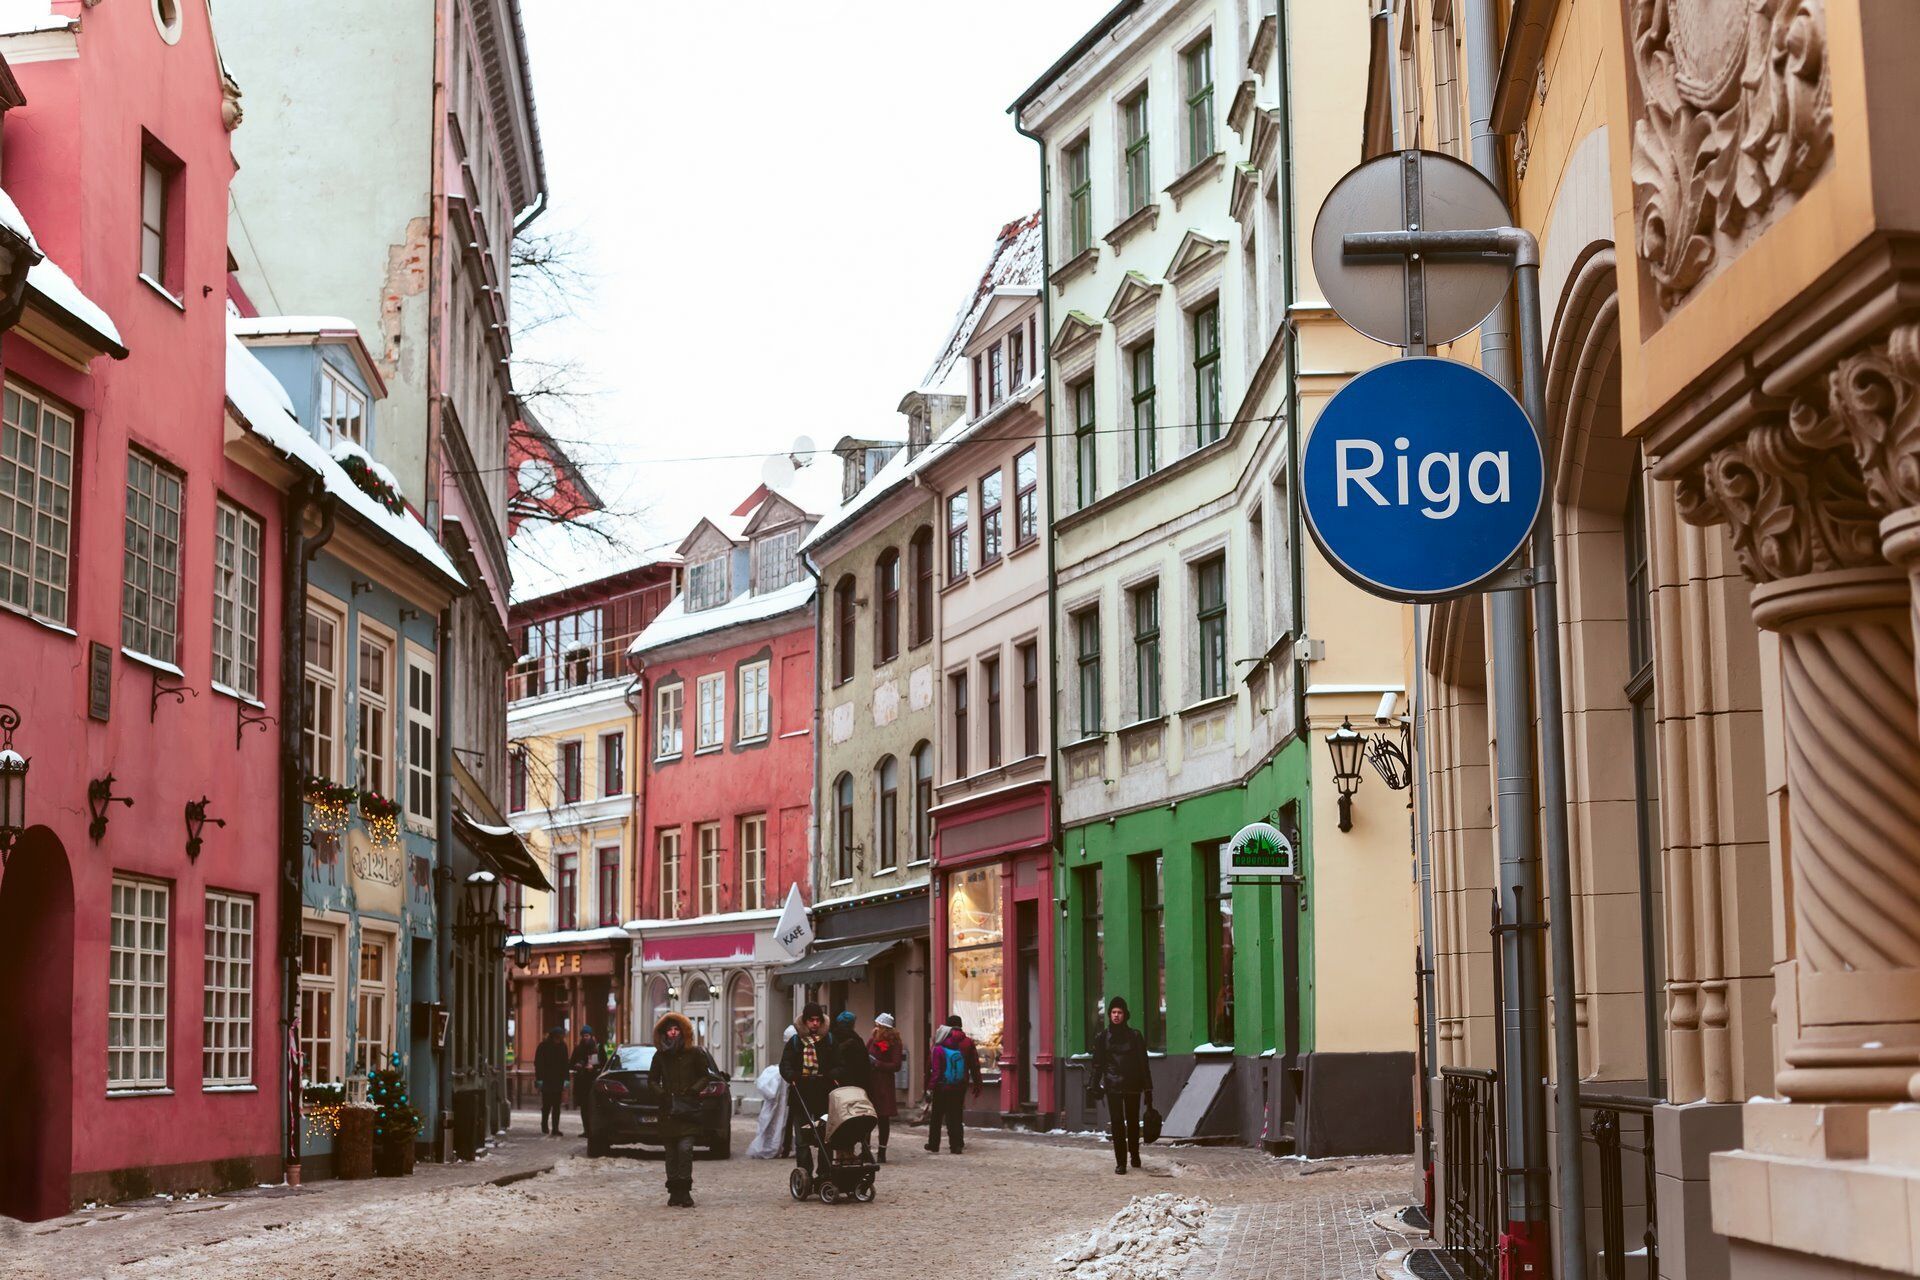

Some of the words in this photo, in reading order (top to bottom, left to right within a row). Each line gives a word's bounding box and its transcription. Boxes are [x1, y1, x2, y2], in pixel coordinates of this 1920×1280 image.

[1335, 437, 1510, 520] Riga
[367, 852, 389, 881] 1221
[782, 925, 805, 945] KAFE
